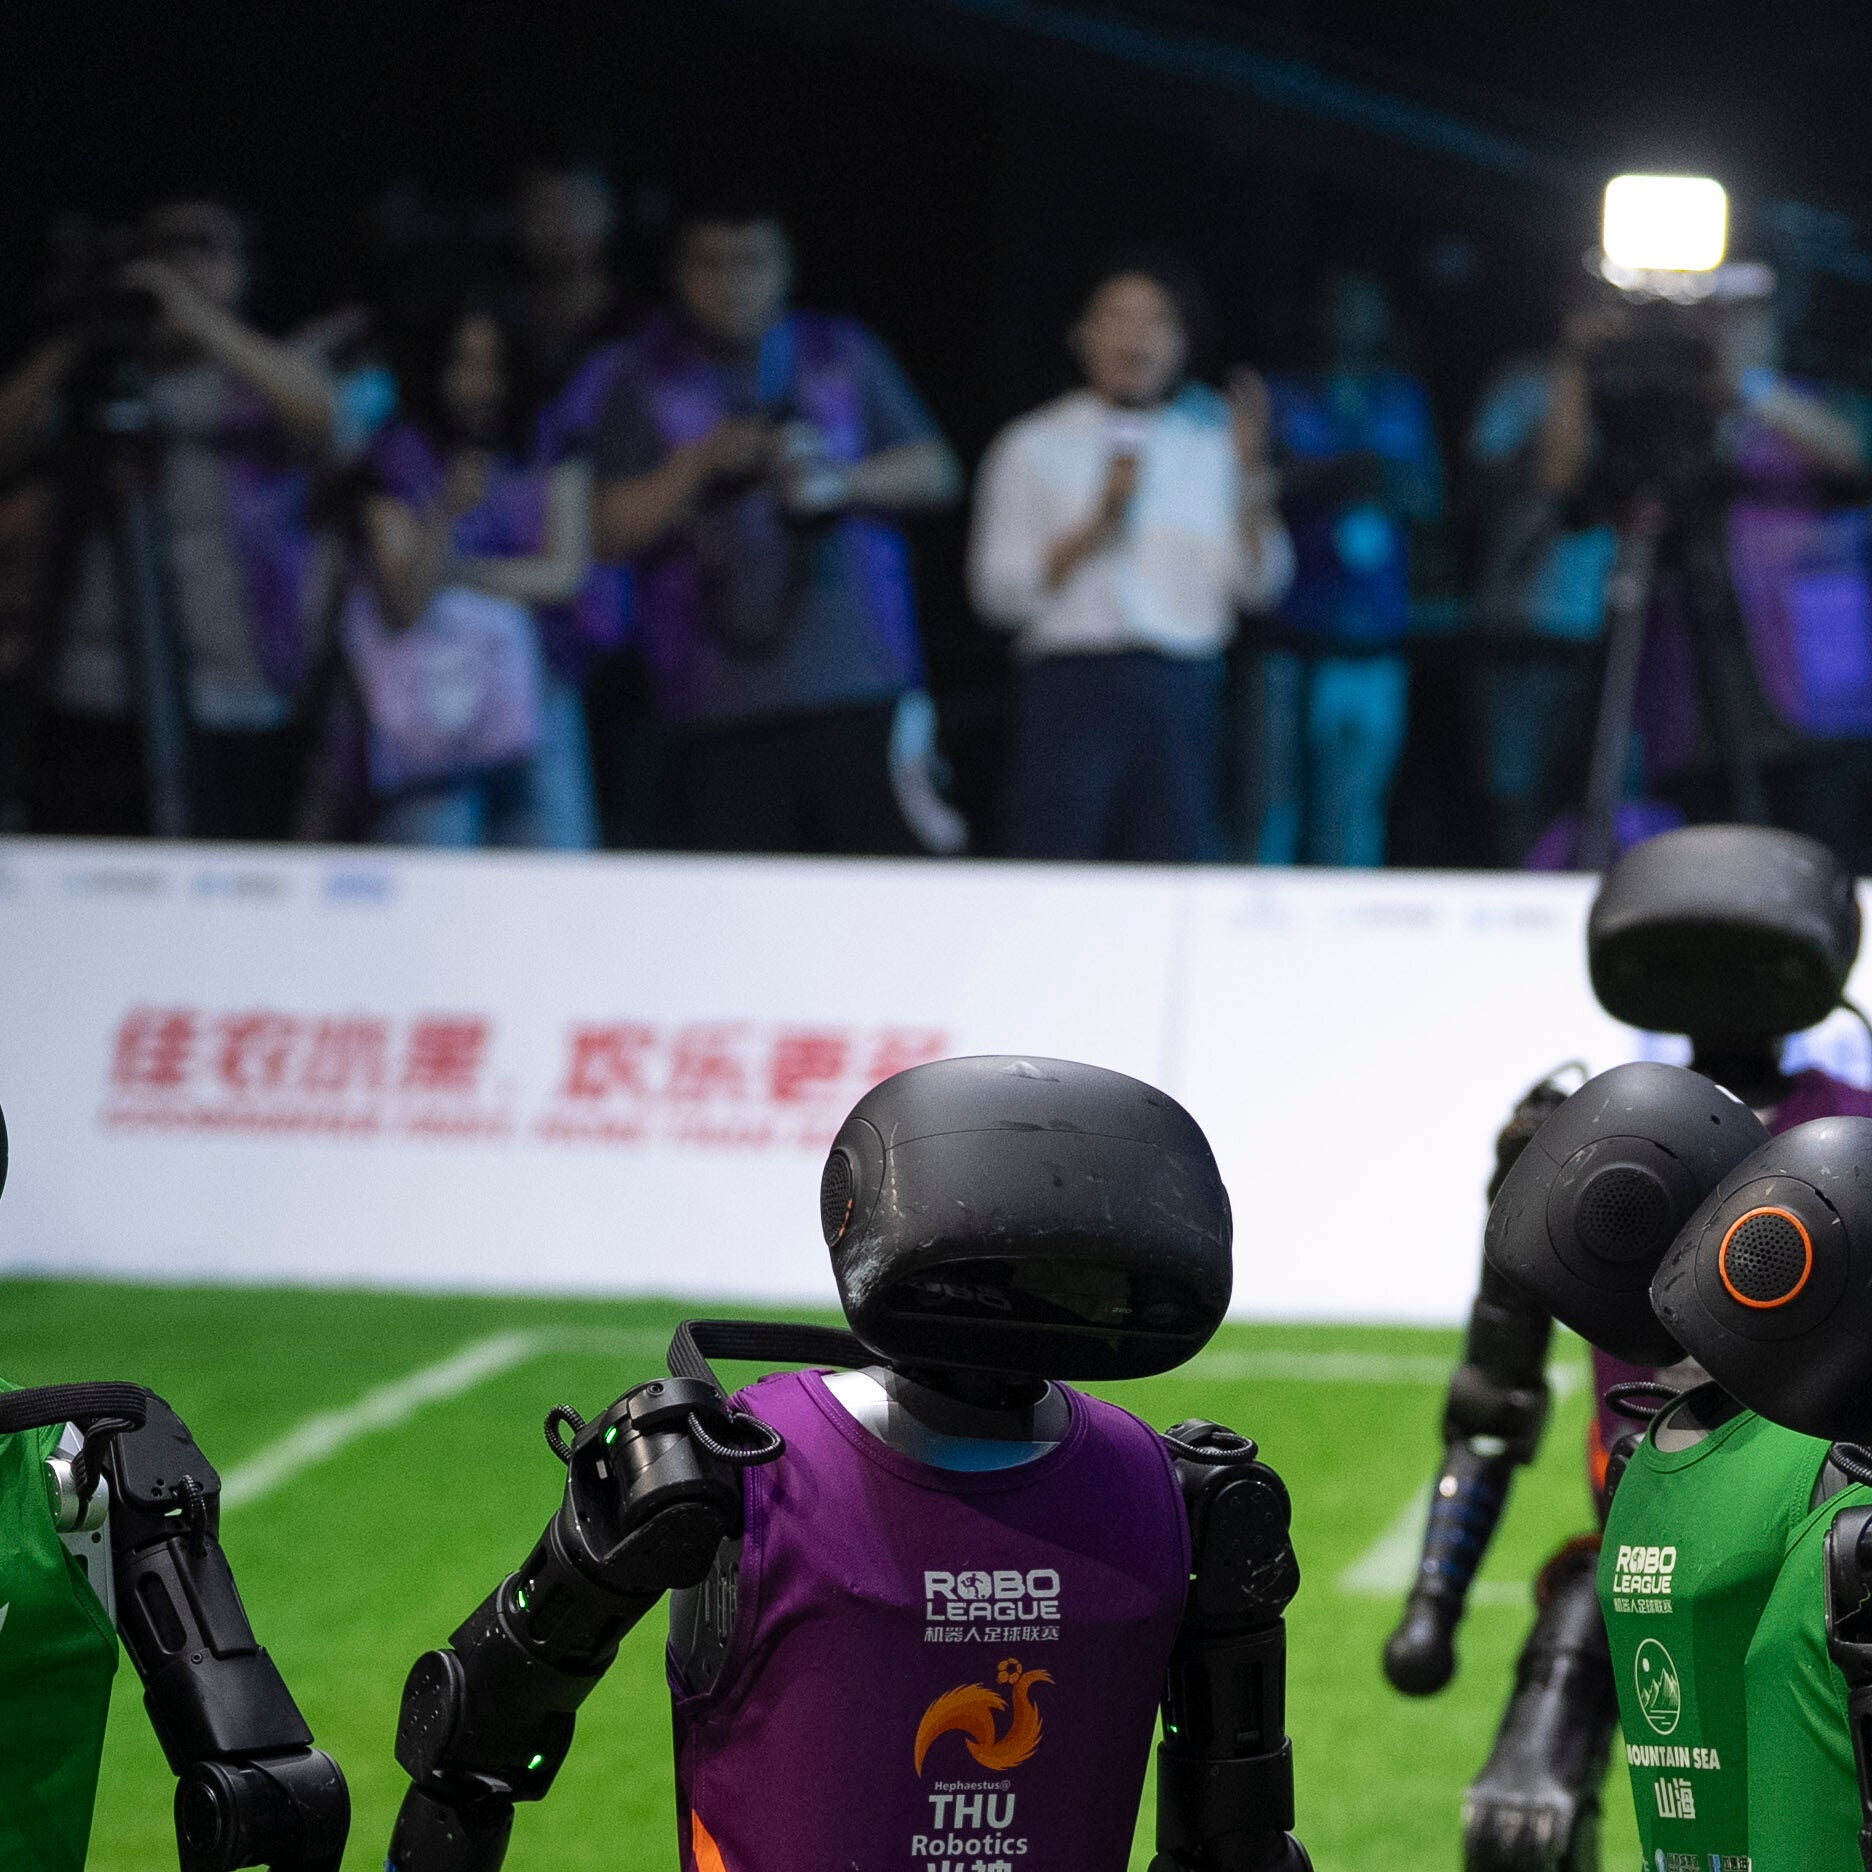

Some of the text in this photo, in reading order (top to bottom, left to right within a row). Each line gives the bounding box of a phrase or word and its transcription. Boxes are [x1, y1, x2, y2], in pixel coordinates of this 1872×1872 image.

[1616, 1545, 1677, 1574] ROBO
[924, 1569, 1061, 1600] ROBO
[1613, 1574, 1673, 1594] LEAGUE
[926, 1600, 1061, 1621] LEAGUE
[924, 1626, 1060, 1642] 机器人足球联赛
[1692, 1747, 1721, 1770] SEA
[934, 1780, 1011, 1792] Hephaestus@
[1654, 1777, 1696, 1819] 山海
[928, 1793, 1016, 1829] THU
[911, 1832, 1028, 1856] Robotics
